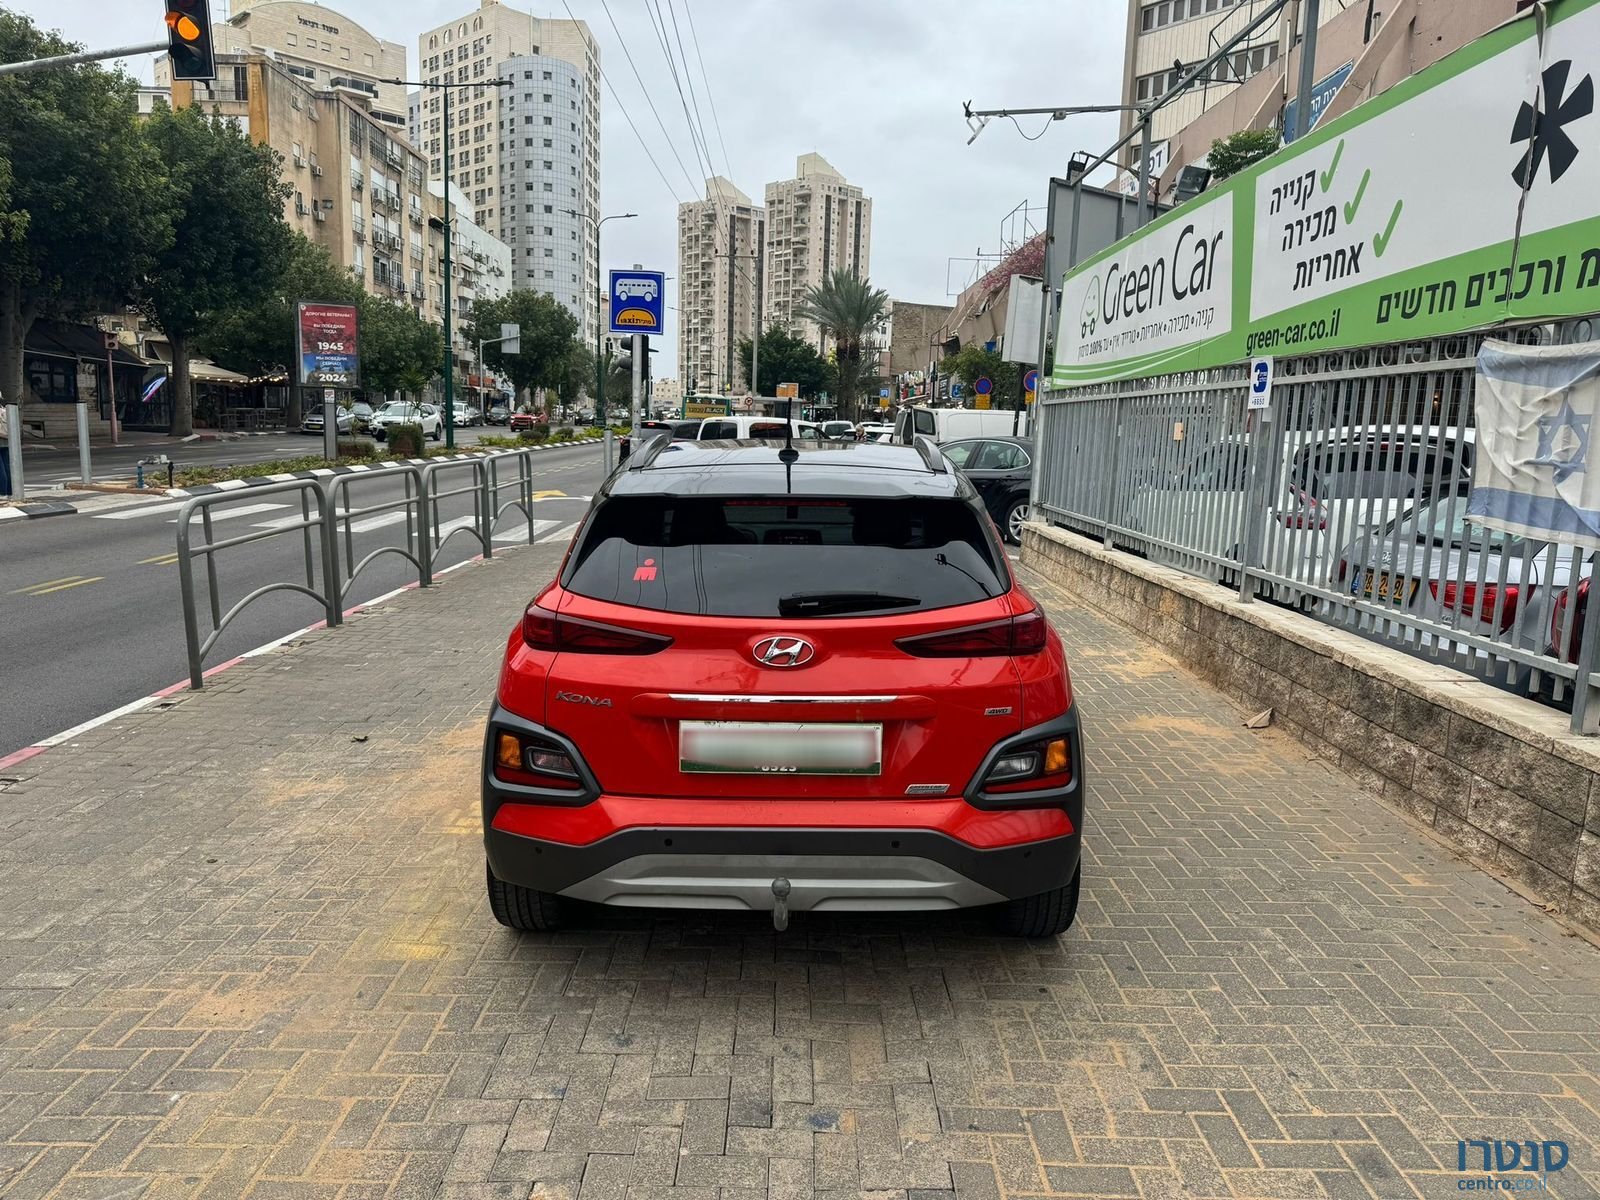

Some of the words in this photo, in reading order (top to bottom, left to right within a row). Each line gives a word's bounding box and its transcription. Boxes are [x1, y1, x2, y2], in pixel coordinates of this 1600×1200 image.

[1270, 169, 1316, 216] קנייה
[1282, 205, 1337, 251] מכירה
[1103, 262, 1165, 325] Green
[1172, 224, 1224, 301] Car
[1293, 242, 1364, 291] אחריות
[1464, 255, 1567, 309] ורכבים
[1167, 314, 1190, 334] מכירה
[1195, 307, 1215, 330] קניה
[1376, 280, 1457, 324] חדשים
[317, 341, 344, 351] 1945
[1140, 321, 1163, 342] אחריות
[1246, 308, 1341, 357] green-car.co.il
[318, 373, 348, 383] 2024
[555, 690, 613, 707] KONA
